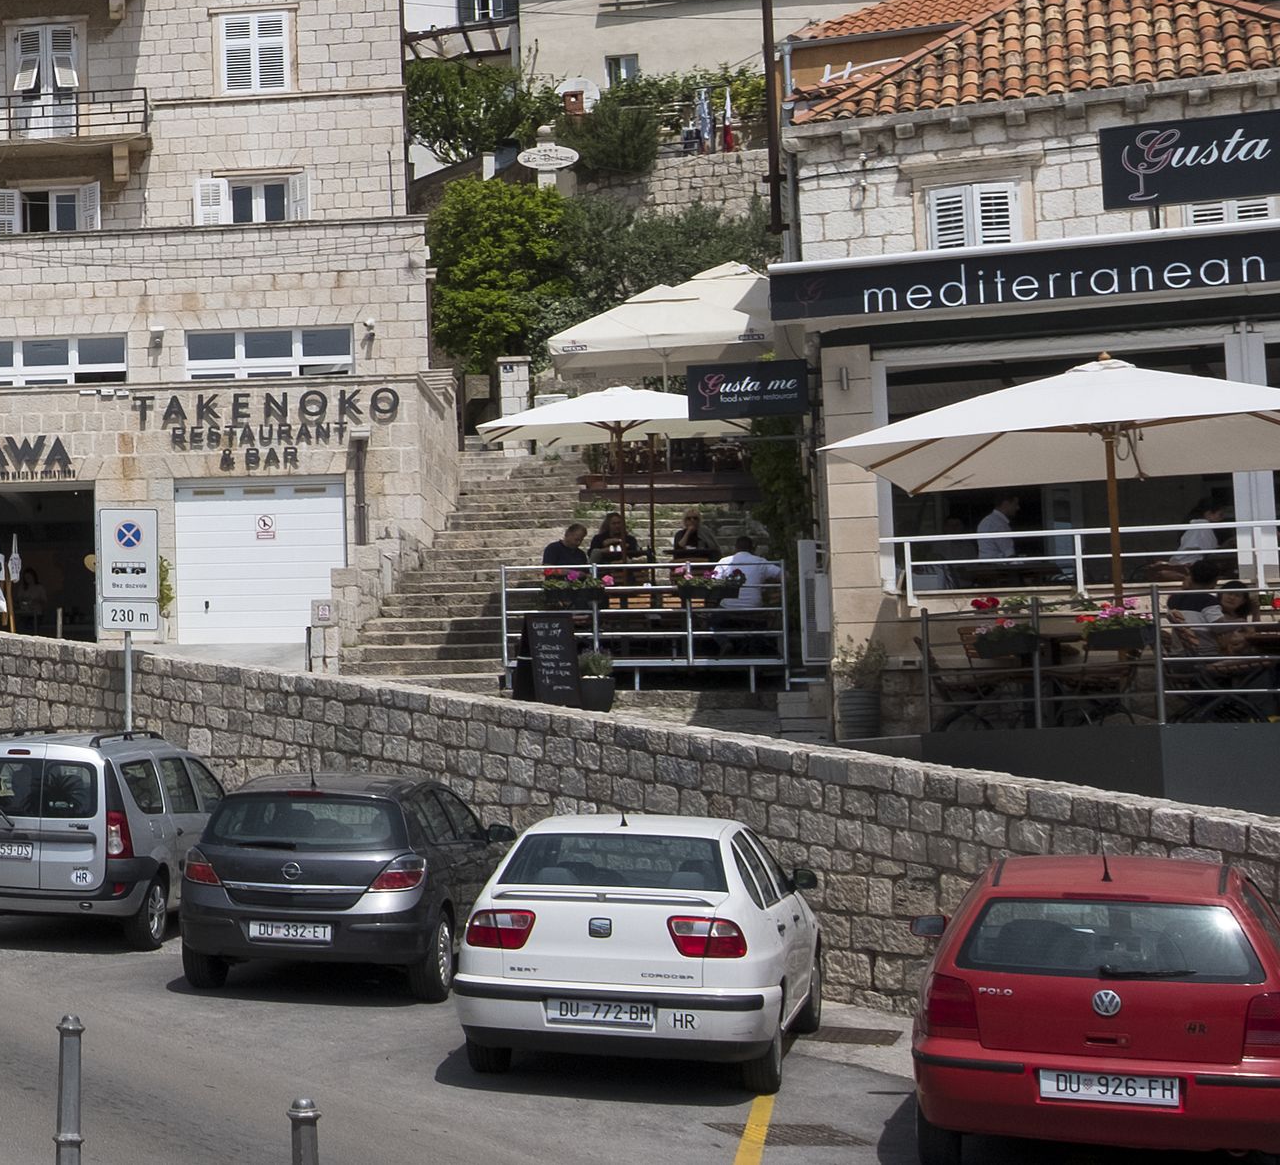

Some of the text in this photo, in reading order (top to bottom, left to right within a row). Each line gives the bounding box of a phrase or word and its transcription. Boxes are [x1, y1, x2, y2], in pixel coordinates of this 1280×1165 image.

[1136, 128, 1272, 169] Gusta
[863, 256, 1267, 313] mediterranean
[703, 374, 798, 394] Gusta me
[133, 387, 400, 423] TAKENOKO
[720, 394, 738, 403] food
[171, 421, 348, 447] RESTAURANT
[245, 446, 299, 469] BAR
[111, 608, 149, 623] 230 m
[75, 872, 88, 883] HR
[258, 923, 274, 936] DU
[978, 986, 1013, 996] POLO
[559, 1001, 580, 1018] DU
[672, 1013, 695, 1029] HR
[1186, 1022, 1207, 1034] HR
[1055, 1073, 1175, 1100] DU 926-FH
